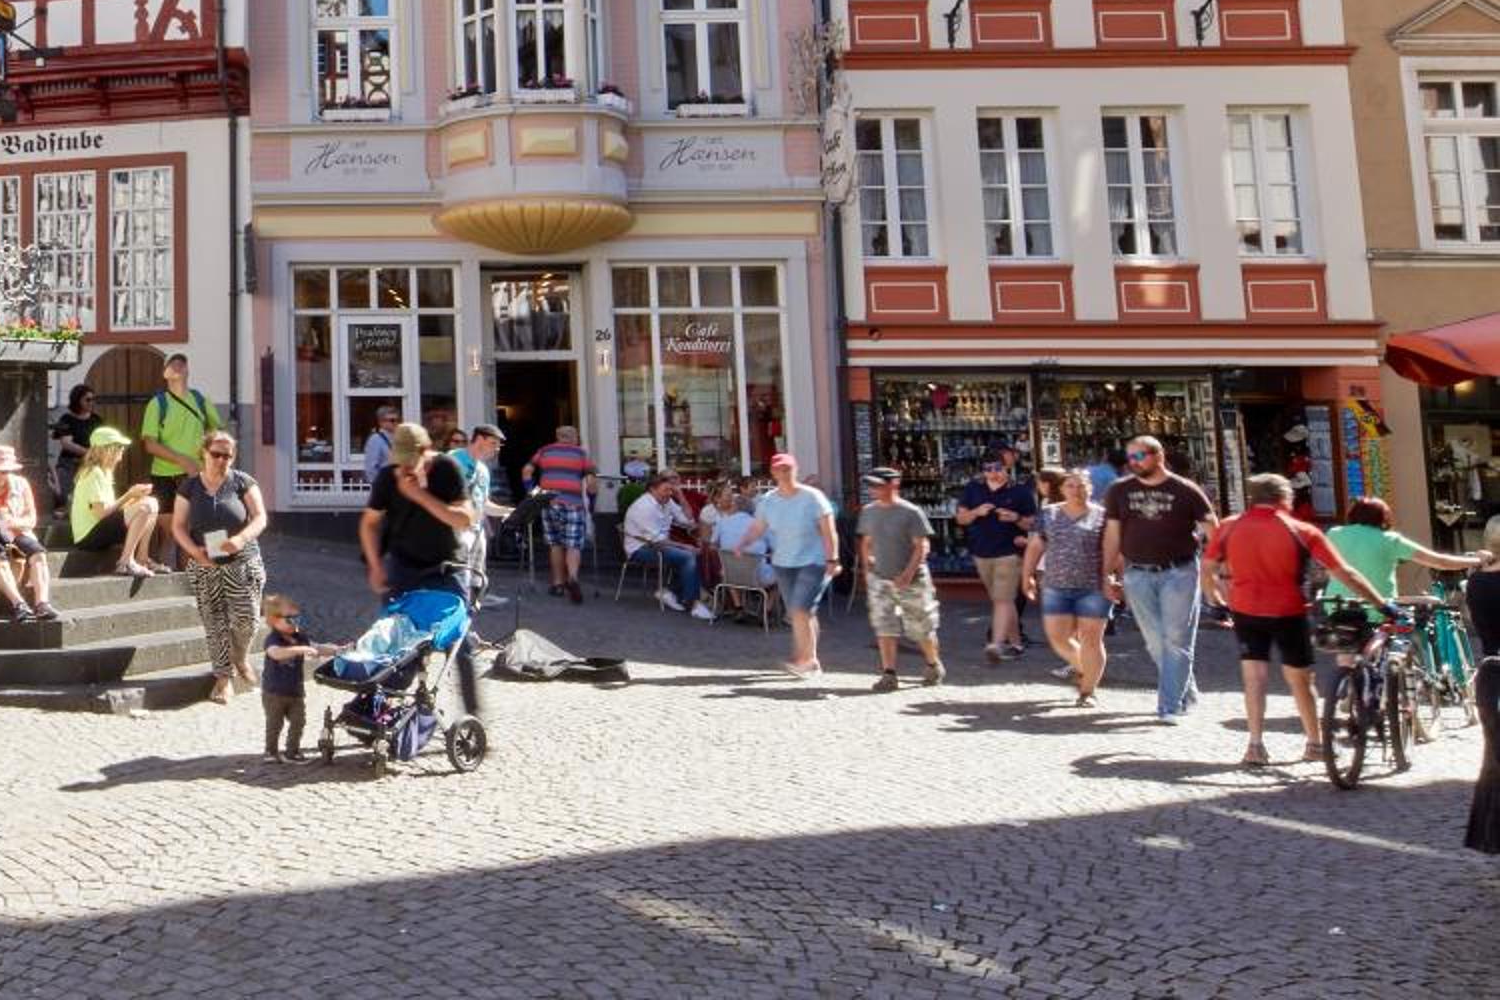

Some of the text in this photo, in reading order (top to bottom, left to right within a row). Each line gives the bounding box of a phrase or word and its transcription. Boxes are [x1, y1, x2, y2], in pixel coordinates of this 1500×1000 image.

[305, 140, 399, 175] Hansen
[659, 135, 757, 171] Hansen
[595, 328, 612, 341] 26
[685, 322, 719, 340] Café
[666, 337, 731, 353] Konditorei
